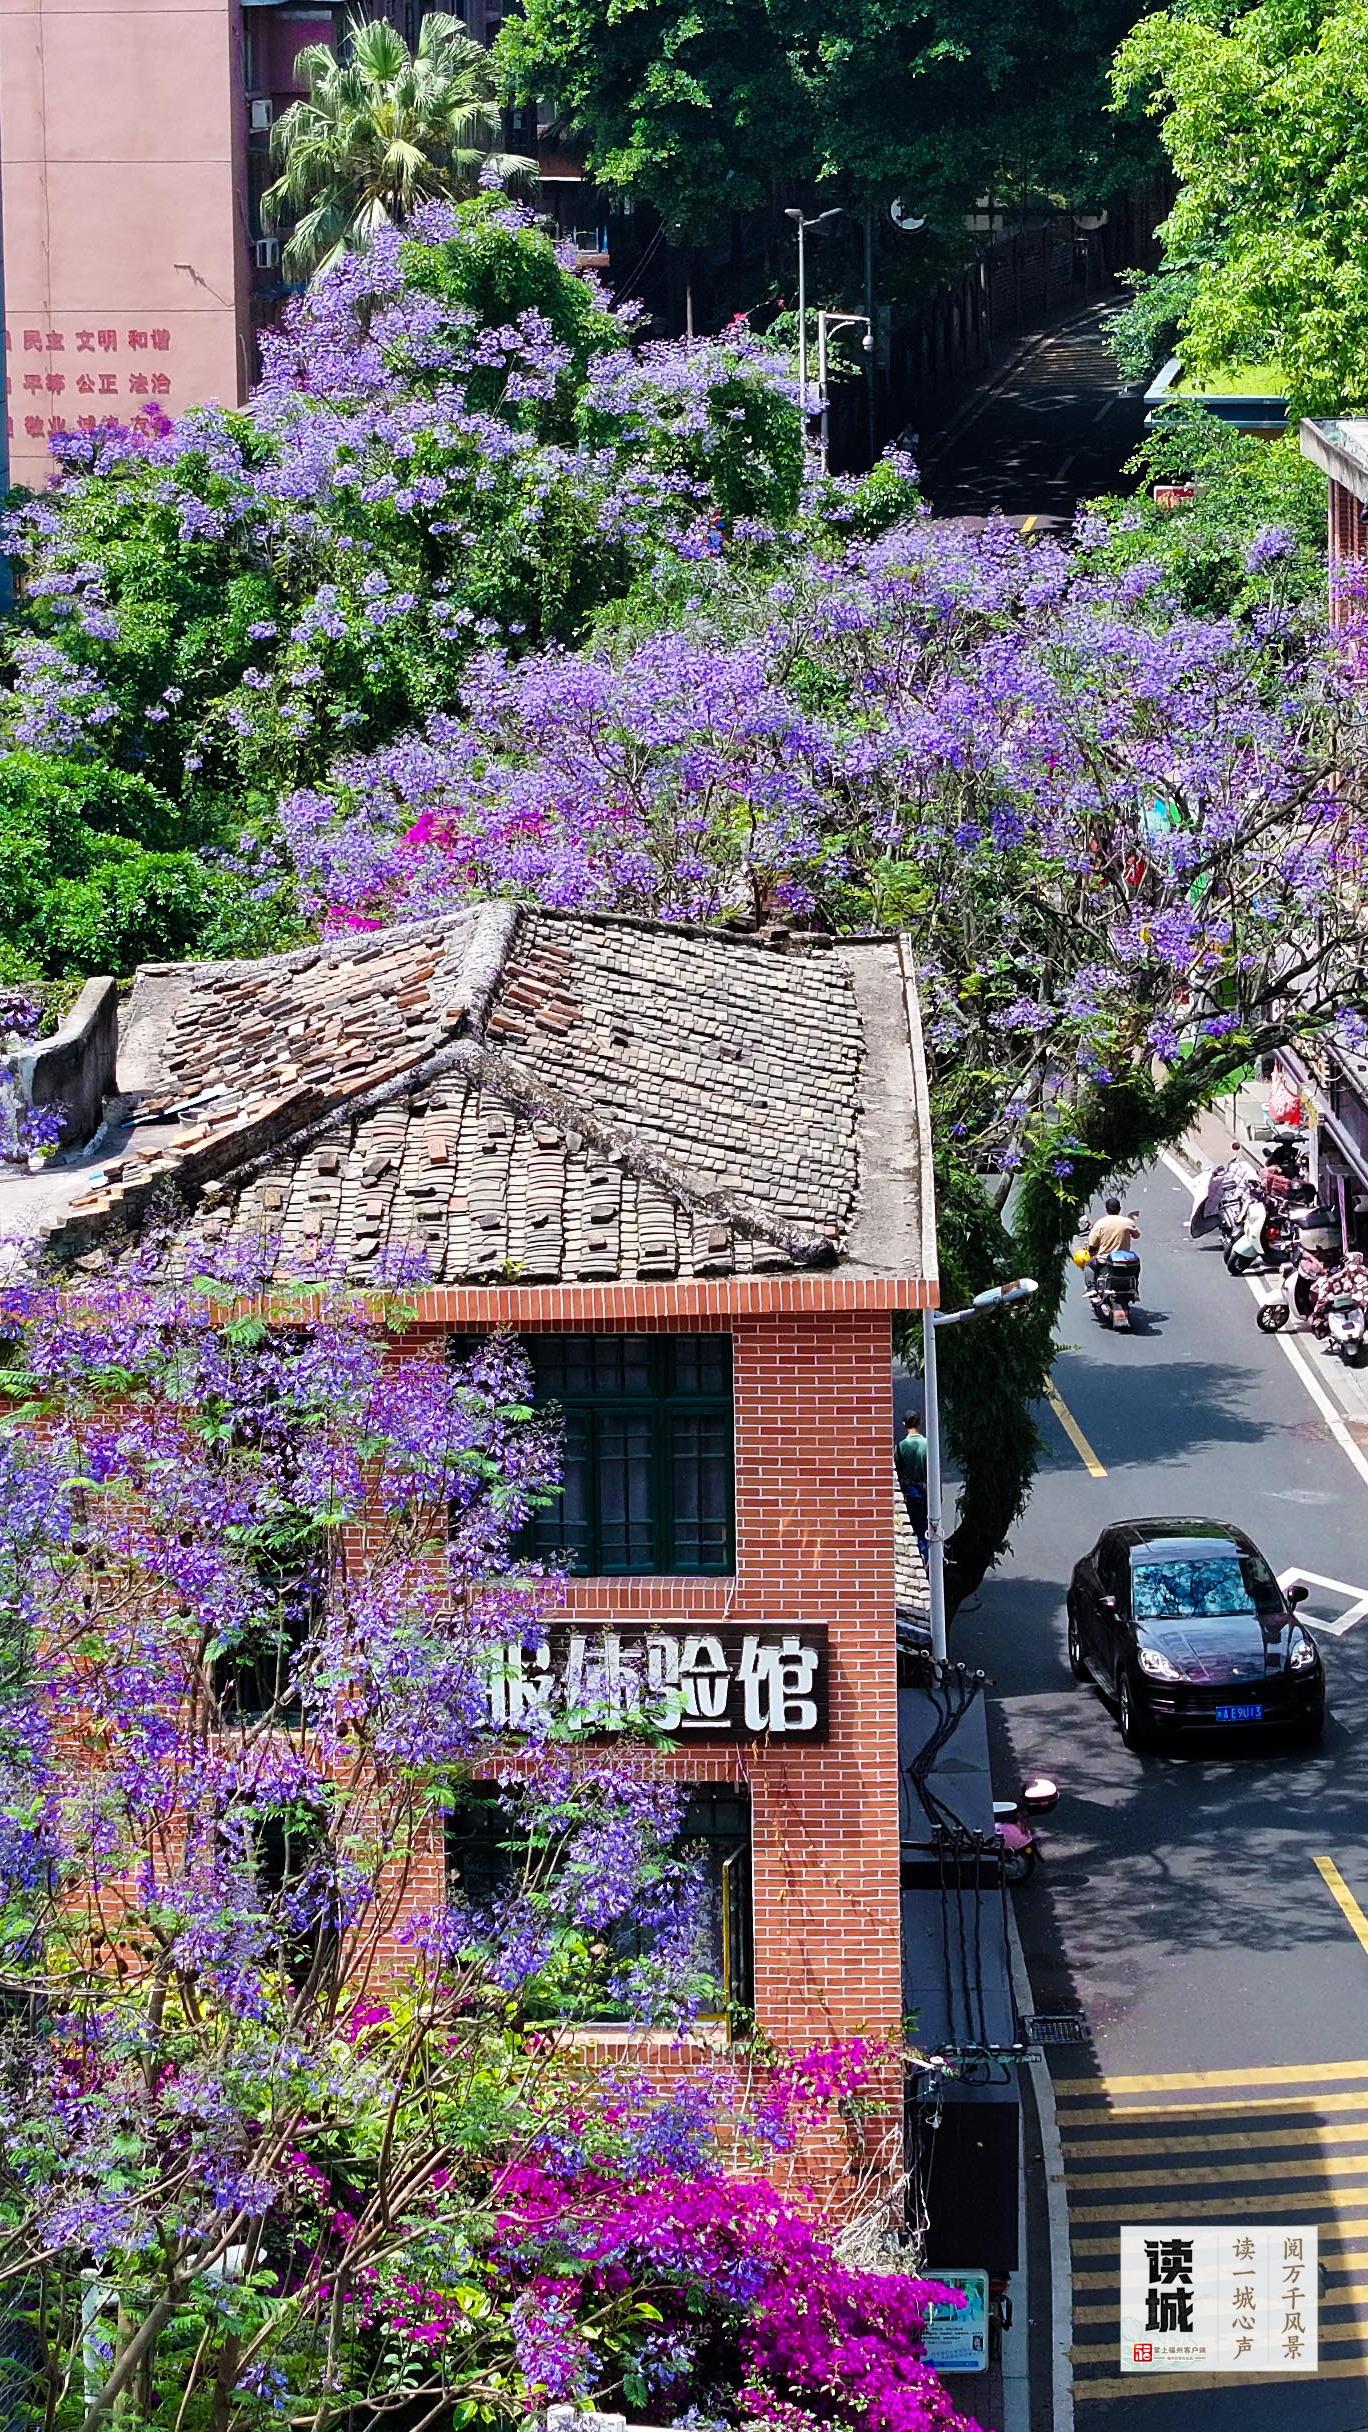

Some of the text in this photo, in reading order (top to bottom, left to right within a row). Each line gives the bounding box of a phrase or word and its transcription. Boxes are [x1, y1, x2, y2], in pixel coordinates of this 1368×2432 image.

[23, 329, 65, 352] 民主
[75, 329, 118, 352] 文明
[127, 329, 171, 352] 和谐
[23, 373, 65, 396] 平等
[76, 373, 118, 395] 公正
[129, 372, 171, 395] 法治
